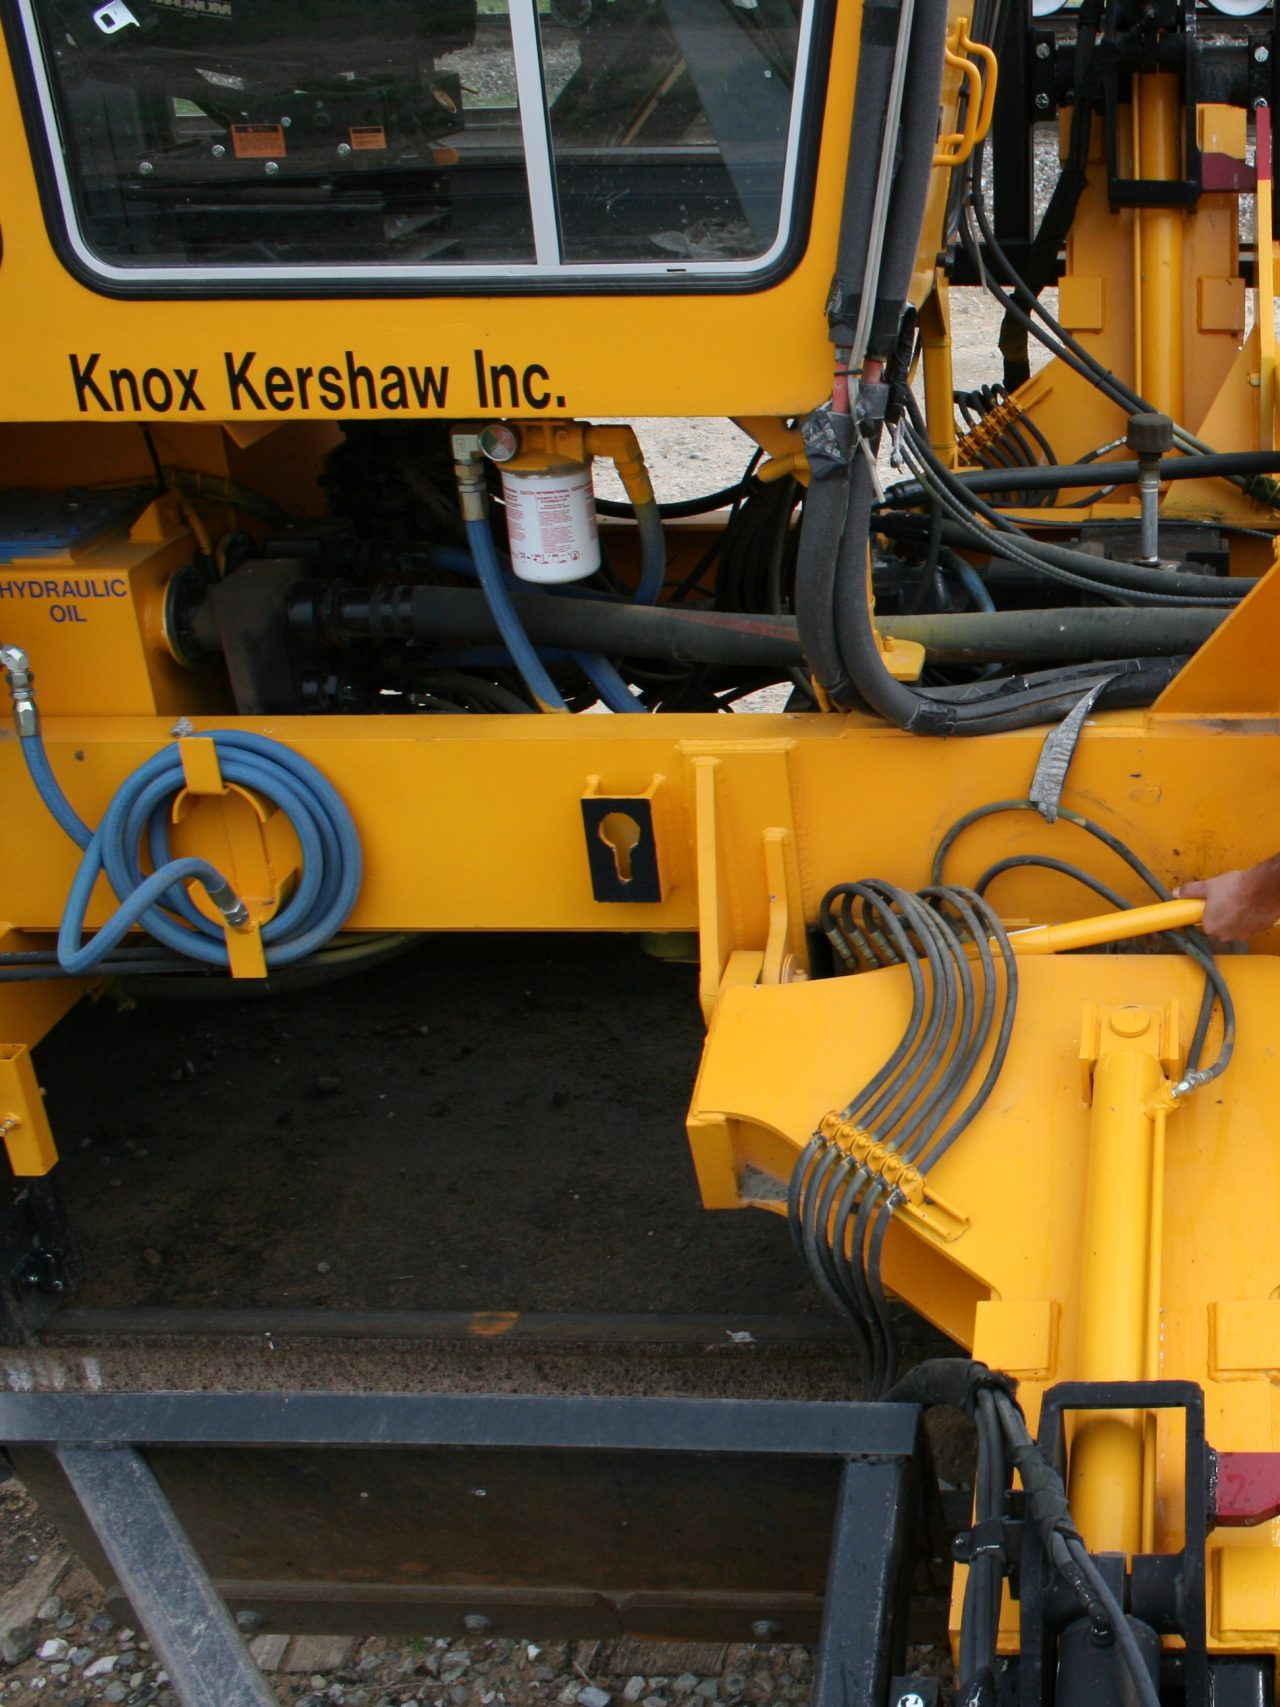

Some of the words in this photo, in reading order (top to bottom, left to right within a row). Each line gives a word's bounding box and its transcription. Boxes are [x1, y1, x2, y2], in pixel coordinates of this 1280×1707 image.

[68, 353, 206, 413] Knox
[224, 350, 449, 412] Kershaw
[474, 349, 566, 410] Inc.
[0, 579, 127, 599] HYDRAULIC
[49, 604, 87, 623] OIL
